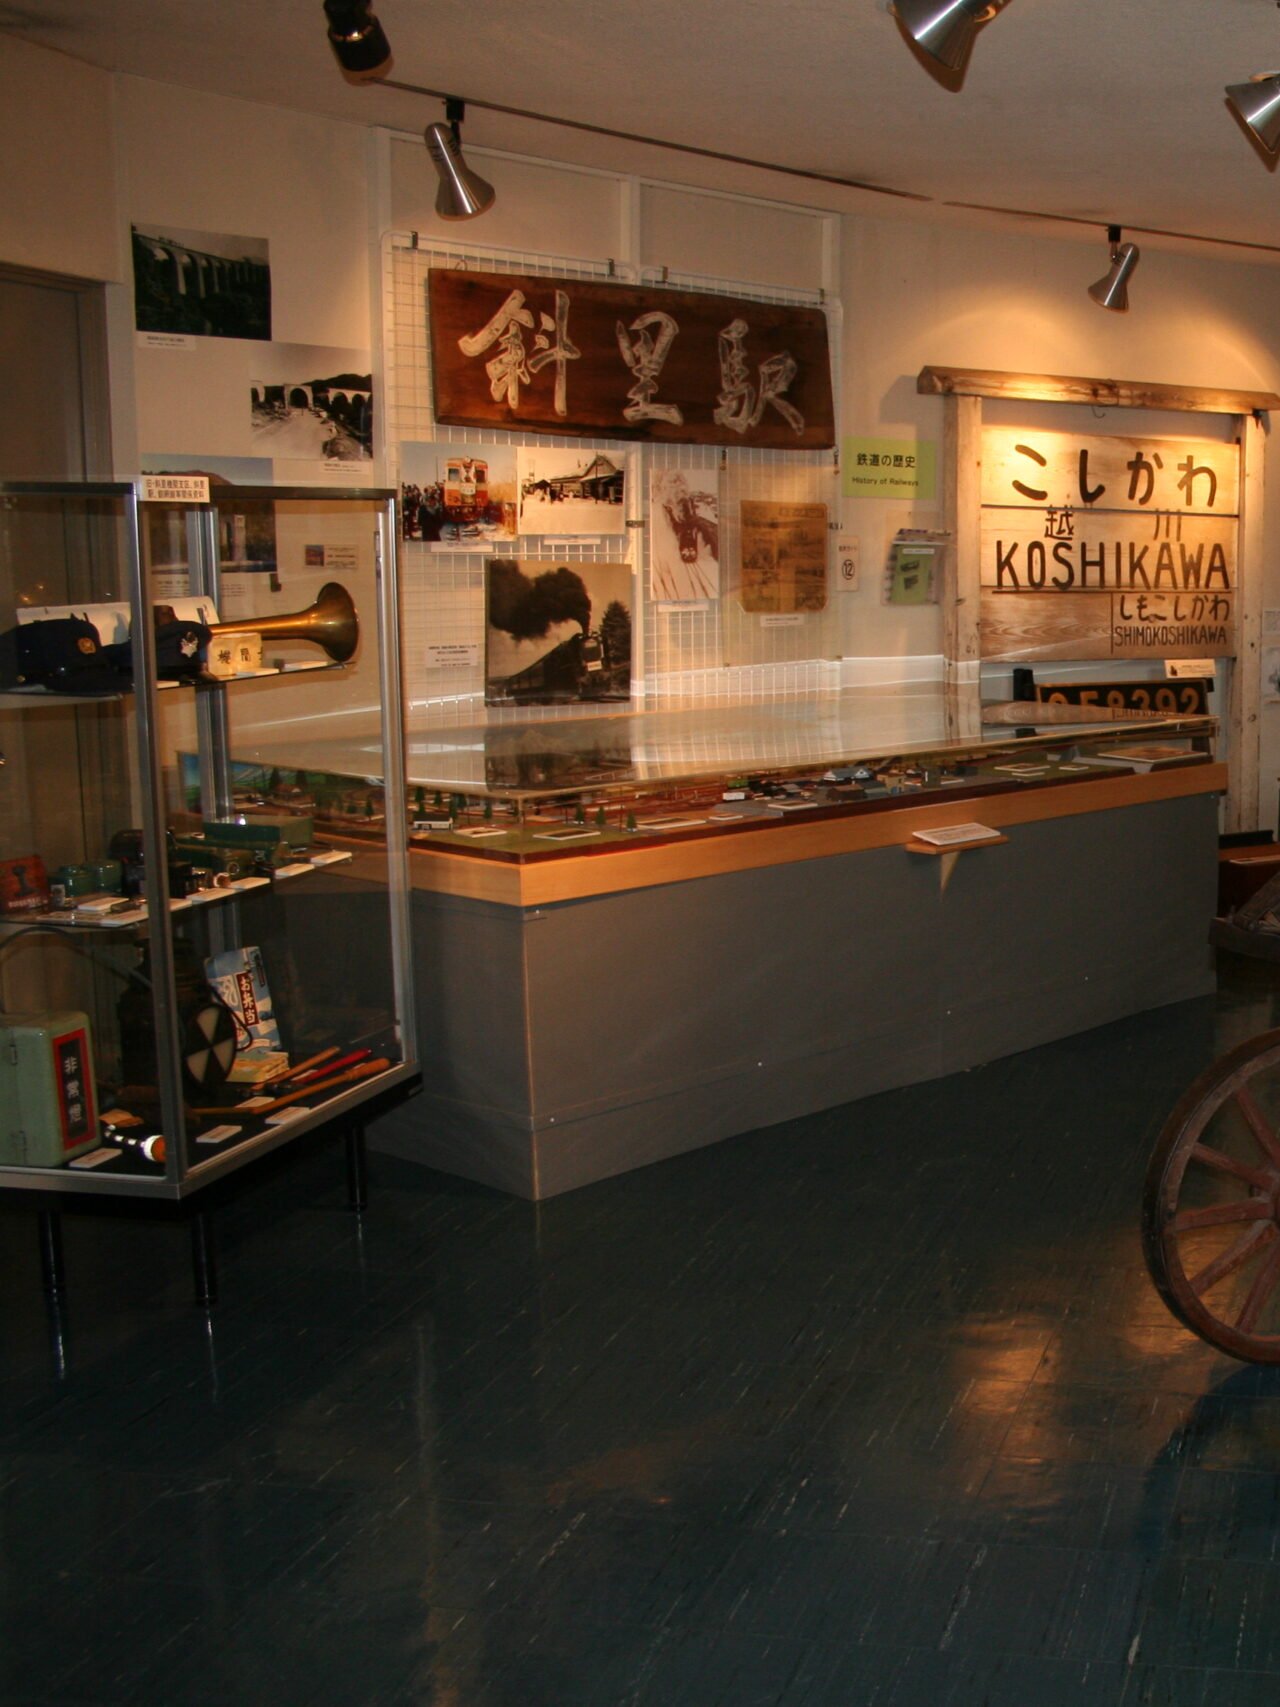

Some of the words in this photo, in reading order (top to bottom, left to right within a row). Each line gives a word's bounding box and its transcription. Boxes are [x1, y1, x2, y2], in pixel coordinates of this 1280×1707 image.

[856, 452, 917, 469] 鉄道の歴史
[1012, 443, 1218, 508] こしかわ
[852, 476, 878, 486] History
[1044, 504, 1075, 541] 越
[996, 539, 1230, 591] KOSHIKAWA
[1113, 625, 1228, 647] SHIMOKOSHIKAWA
[240, 975, 256, 1025] お弁当
